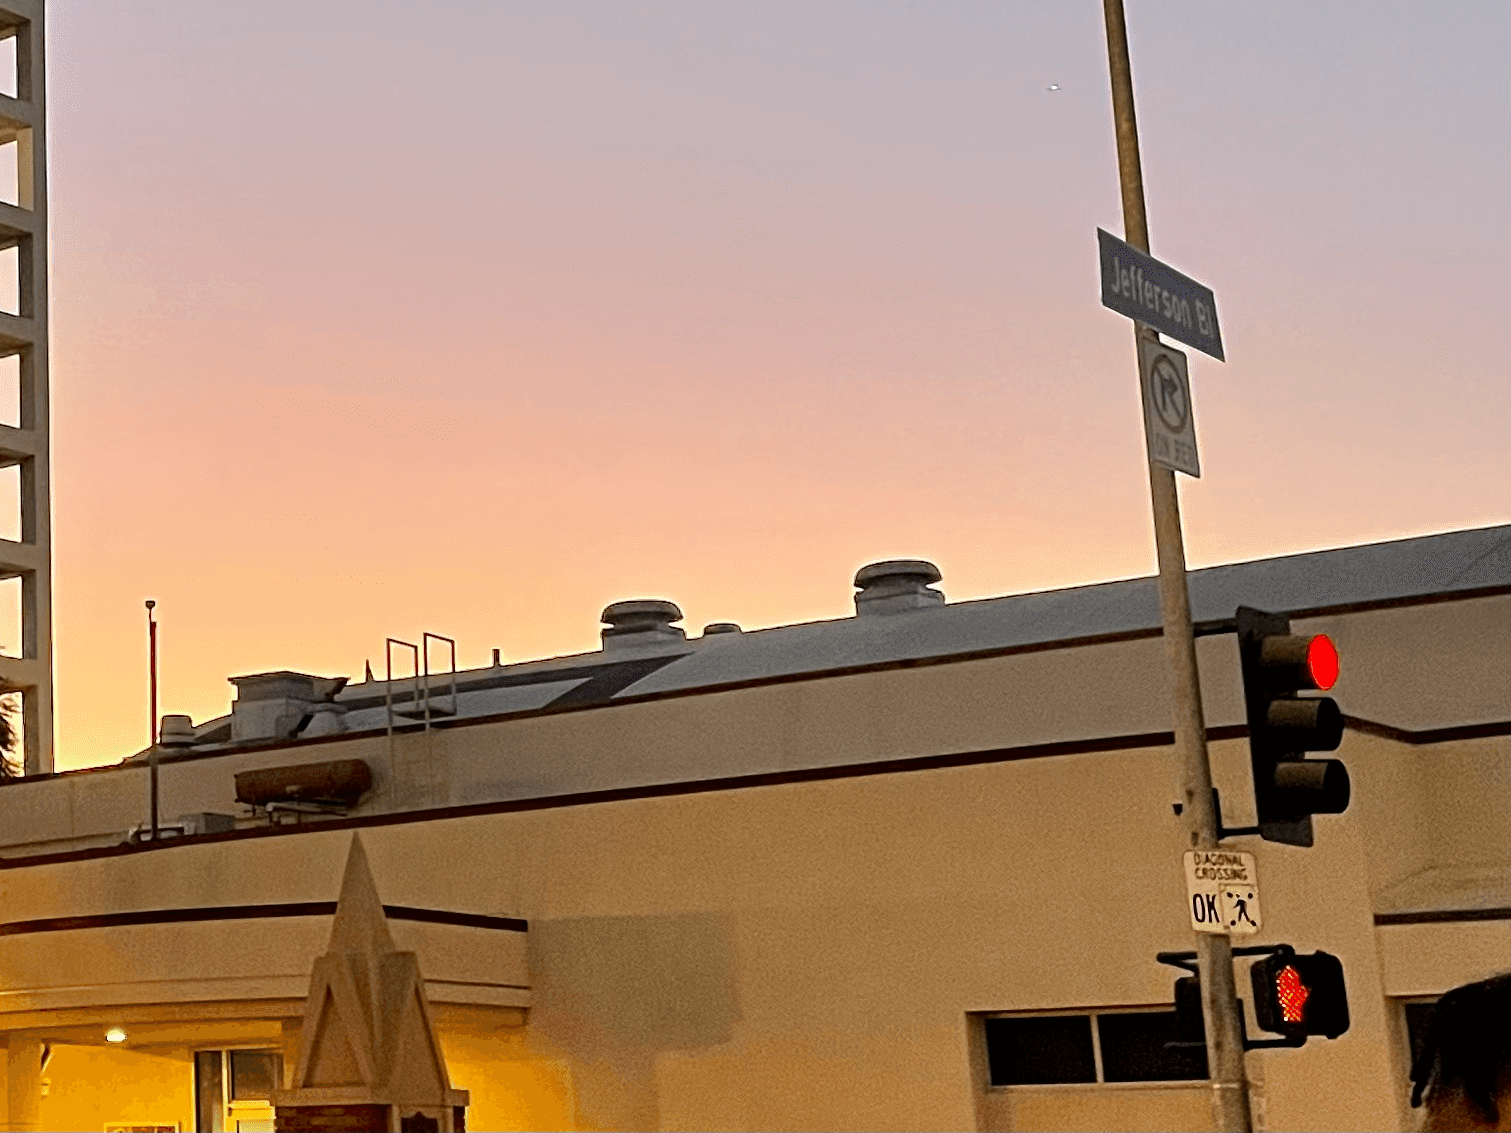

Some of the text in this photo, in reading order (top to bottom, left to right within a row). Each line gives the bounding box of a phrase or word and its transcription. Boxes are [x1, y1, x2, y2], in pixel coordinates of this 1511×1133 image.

[1111, 257, 1190, 328] Jefferson
[1193, 853, 1244, 866] DIAGONAL
[1195, 867, 1247, 880] CROSSING
[1192, 893, 1220, 923] OK
